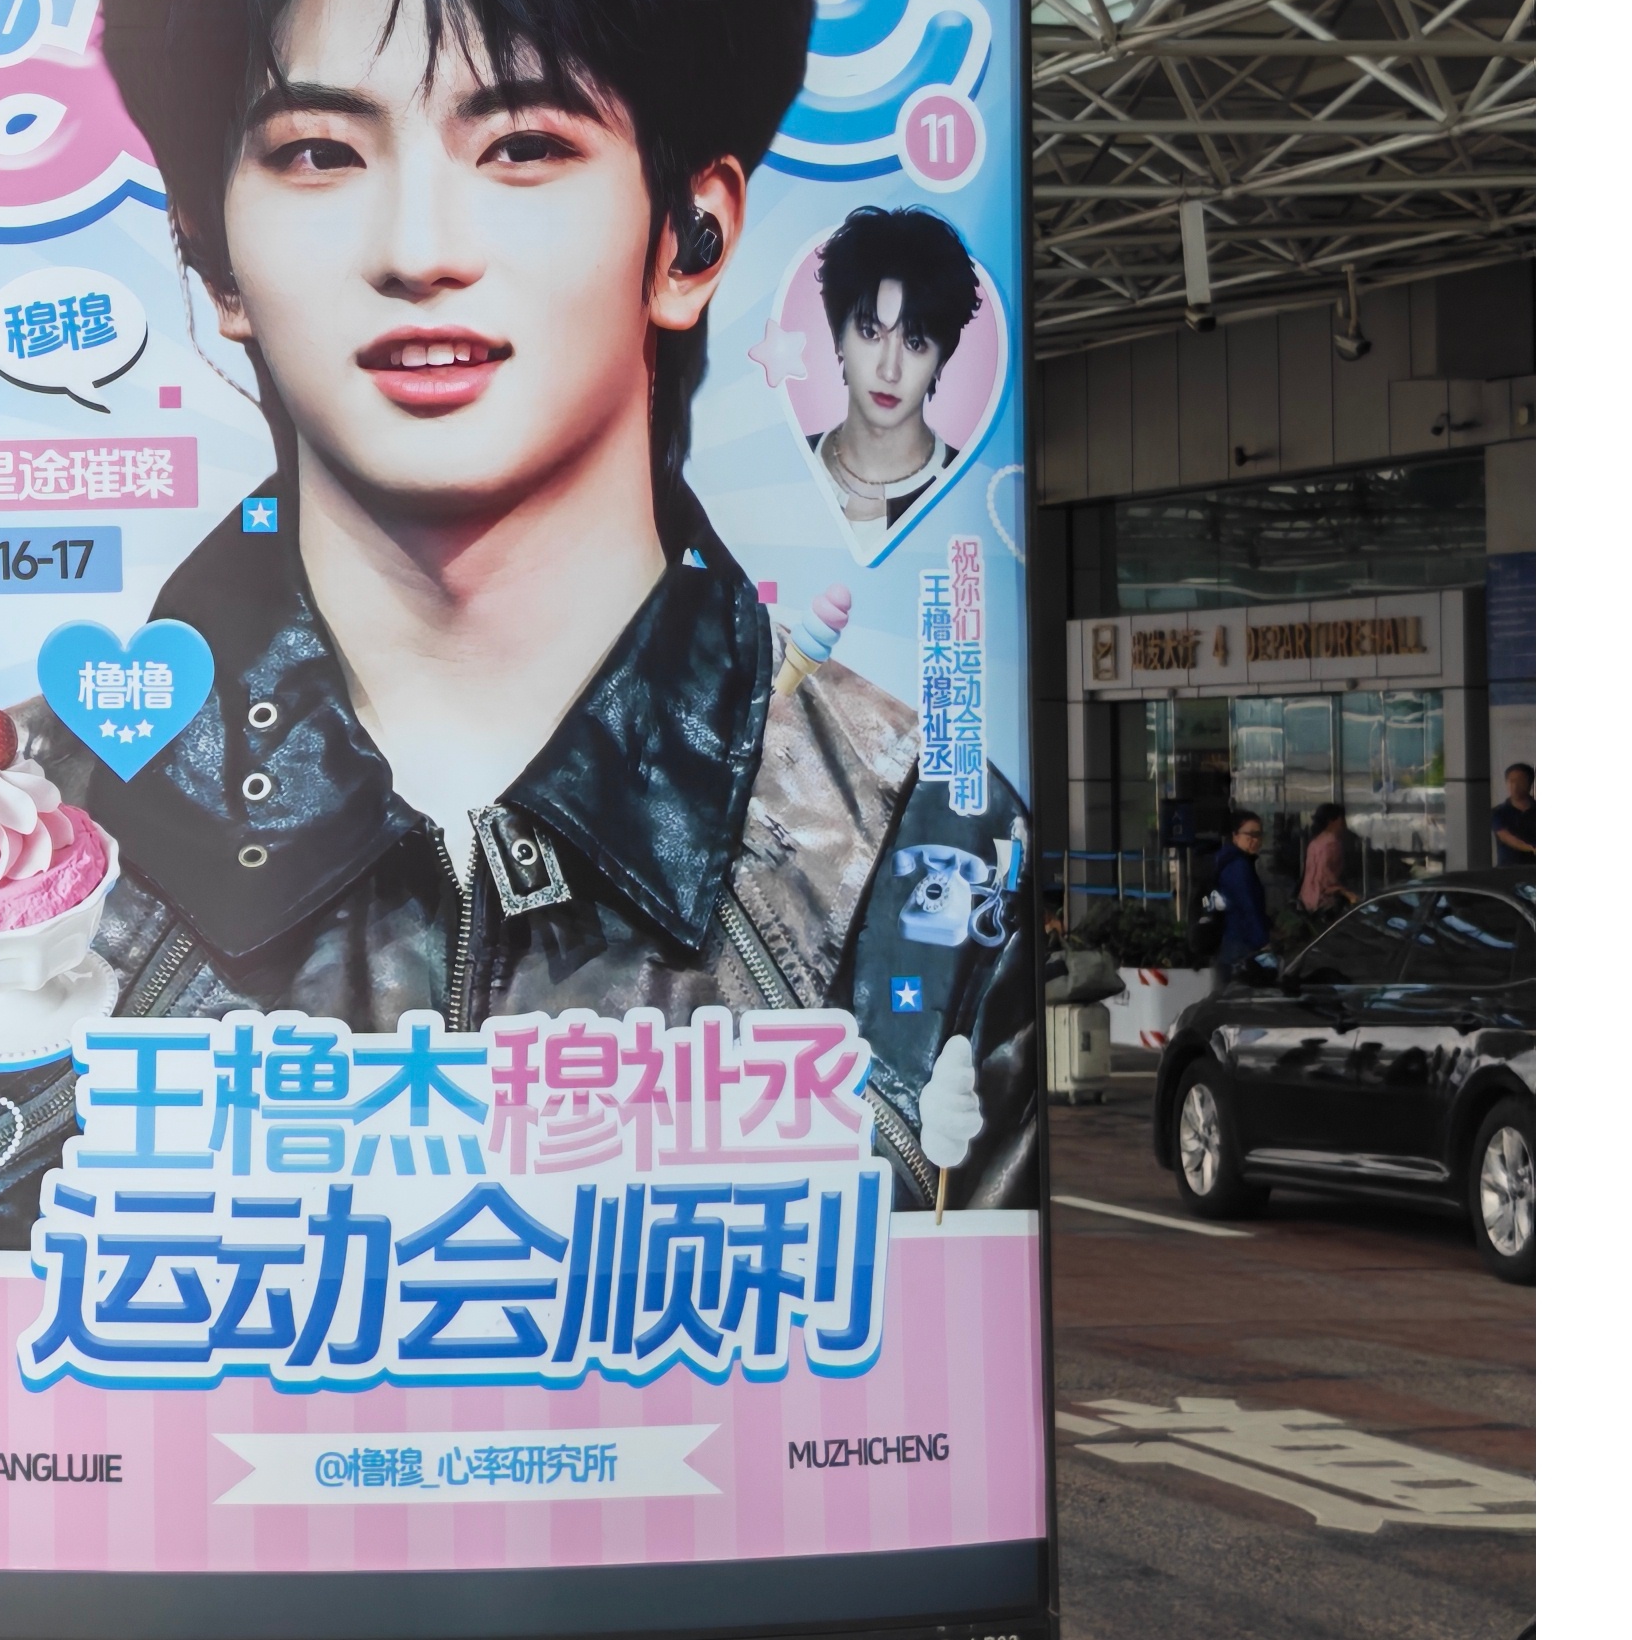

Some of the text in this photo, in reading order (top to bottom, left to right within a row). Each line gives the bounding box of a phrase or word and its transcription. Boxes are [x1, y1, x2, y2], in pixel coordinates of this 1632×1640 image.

[920, 113, 955, 163] 11
[4, 292, 117, 359] 穆穆
[78, 661, 175, 711] 橹橹
[922, 575, 952, 776] 王橹杰穆祉丞
[951, 540, 983, 810] 祝你们运动会顺利
[77, 1020, 860, 1176] 王橹杰穆祉丞
[31, 1170, 877, 1367] 运动会顺利
[315, 1443, 617, 1489] @橹穆_心率研究所
[788, 1433, 950, 1470] MUZHICHENG
